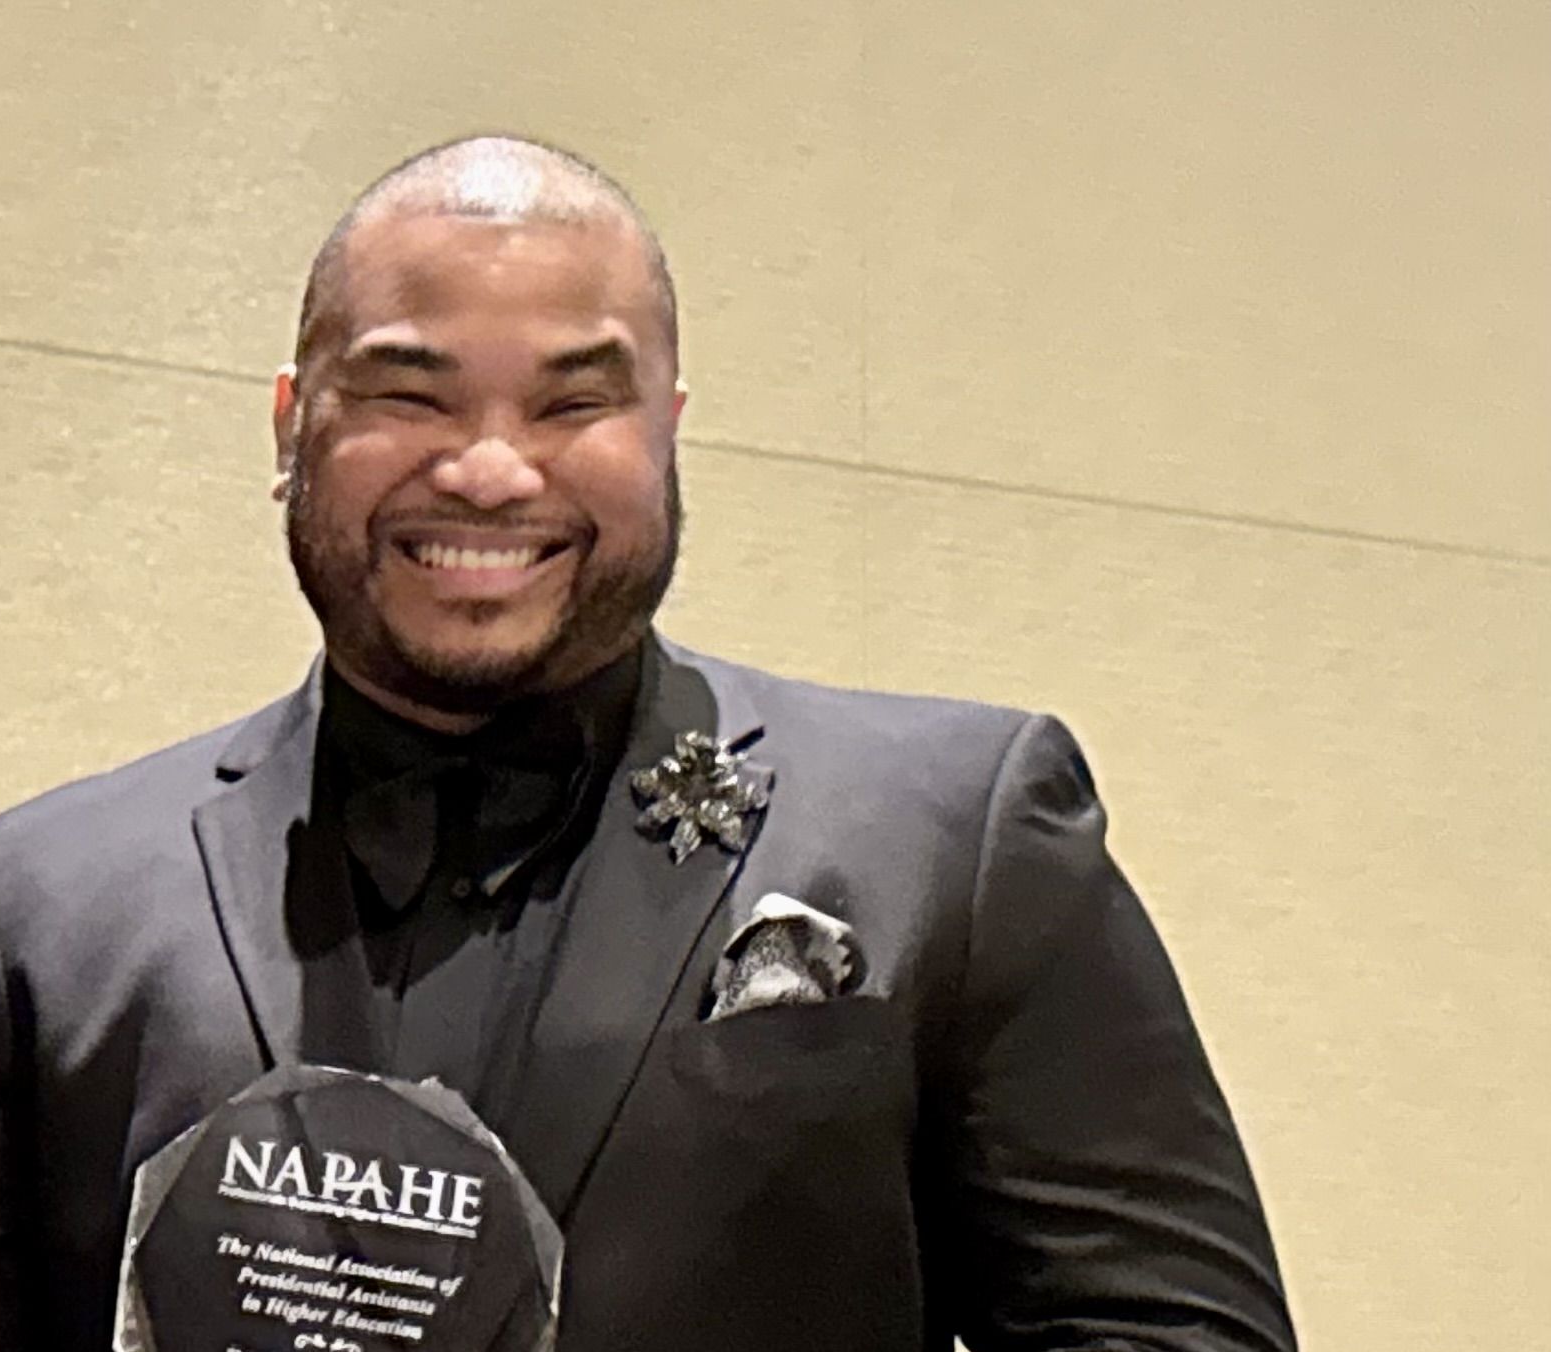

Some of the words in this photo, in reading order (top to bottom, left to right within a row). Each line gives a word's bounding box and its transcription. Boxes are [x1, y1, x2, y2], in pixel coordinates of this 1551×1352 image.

[221, 1135, 483, 1228] NAPAHE
[217, 1235, 252, 1258] The
[253, 1242, 337, 1272] National
[439, 1276, 465, 1298] of
[264, 1297, 330, 1326] Higher
[331, 1308, 423, 1341] Education
